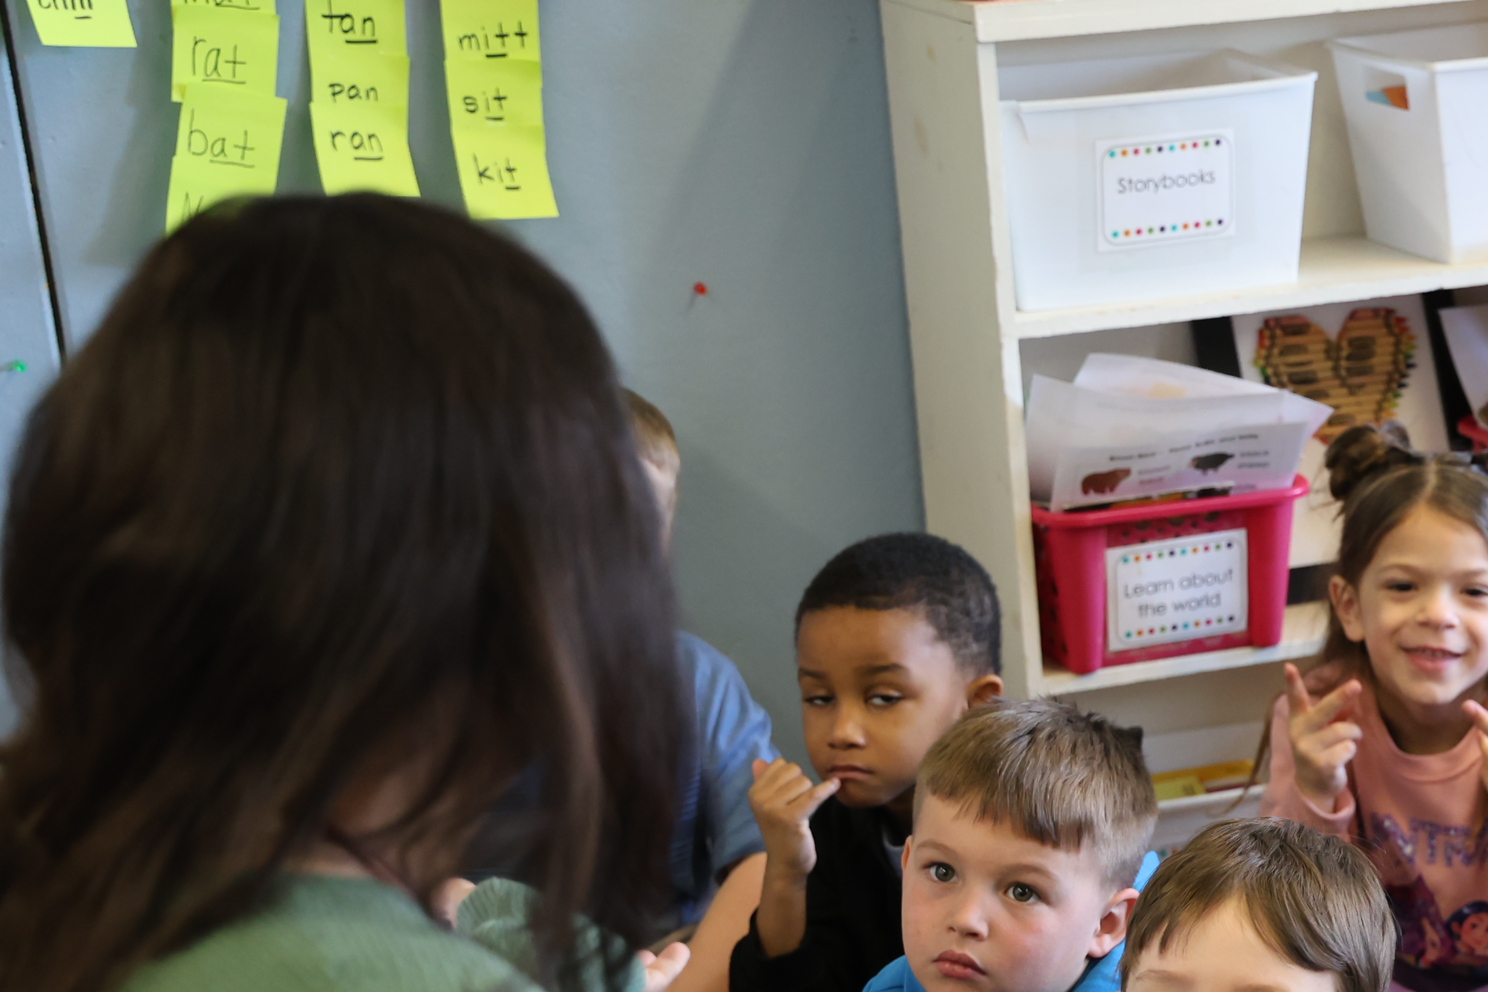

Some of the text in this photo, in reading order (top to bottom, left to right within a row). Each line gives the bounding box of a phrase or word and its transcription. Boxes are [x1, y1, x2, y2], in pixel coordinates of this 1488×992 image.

[321, 0, 376, 36] tan
[457, 21, 529, 51] mitt
[191, 36, 247, 79] rat
[328, 82, 379, 103] pan
[462, 87, 508, 114] sit
[187, 108, 256, 160] bat
[330, 130, 384, 153] ran
[472, 152, 518, 185] kit
[1117, 169, 1216, 194] Storybooks
[1123, 568, 1234, 599] Learn about
[1138, 593, 1222, 618] the world
